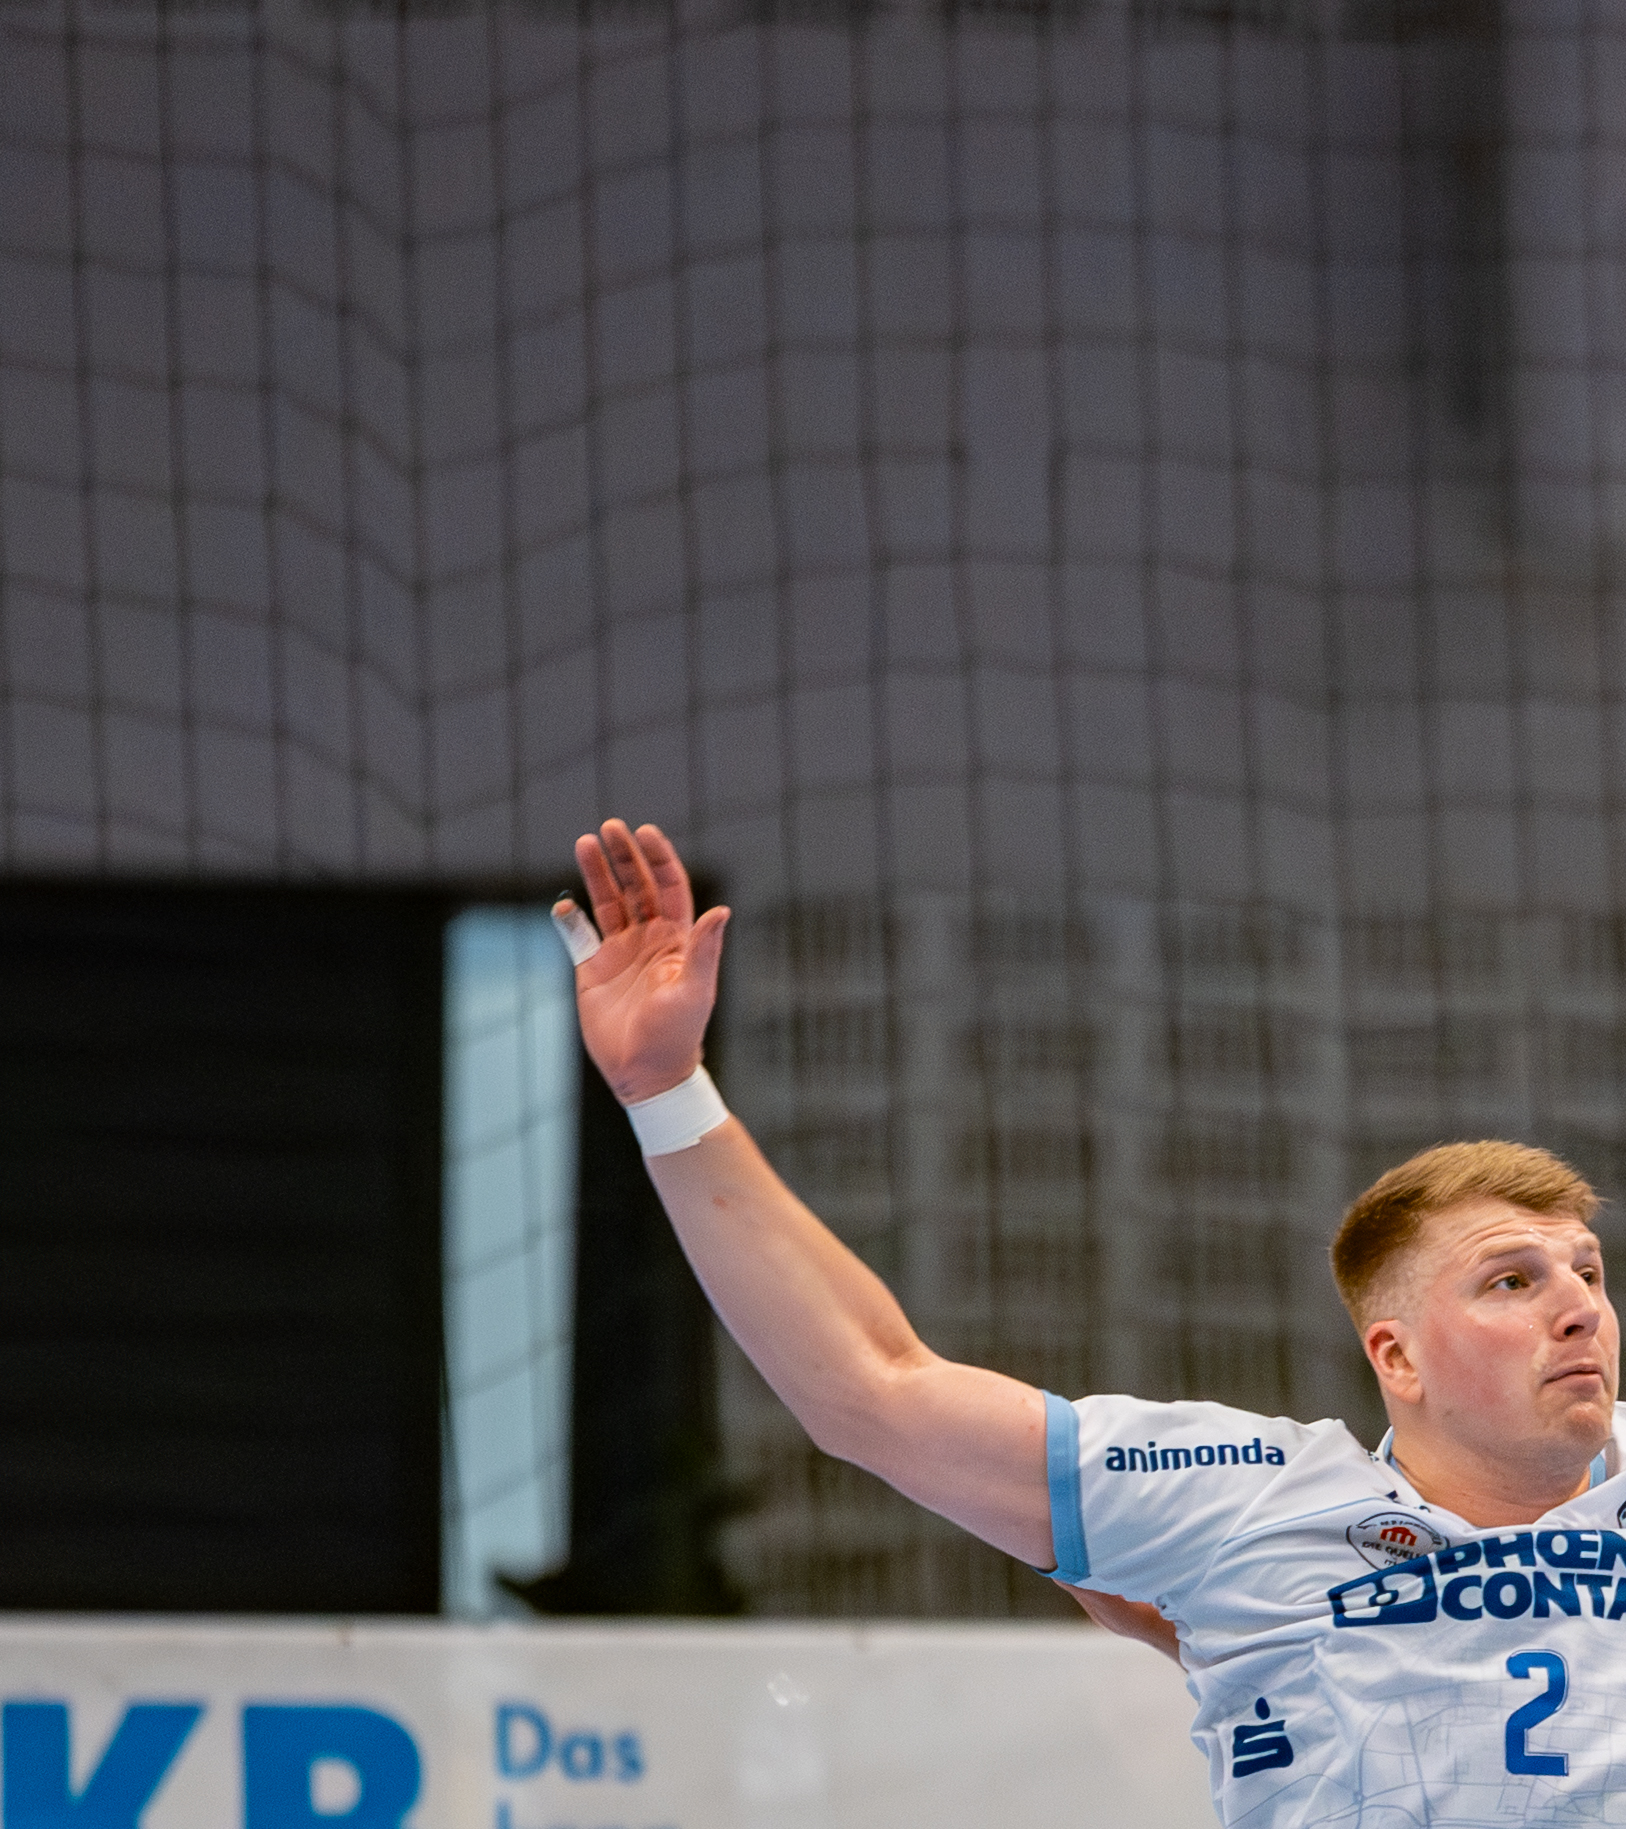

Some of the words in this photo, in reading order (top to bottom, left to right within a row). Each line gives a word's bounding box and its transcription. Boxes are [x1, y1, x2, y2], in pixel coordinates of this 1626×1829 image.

[1105, 1436, 1286, 1474] animonda
[497, 1704, 645, 1782] Das
[1504, 1648, 1570, 1778] 2
